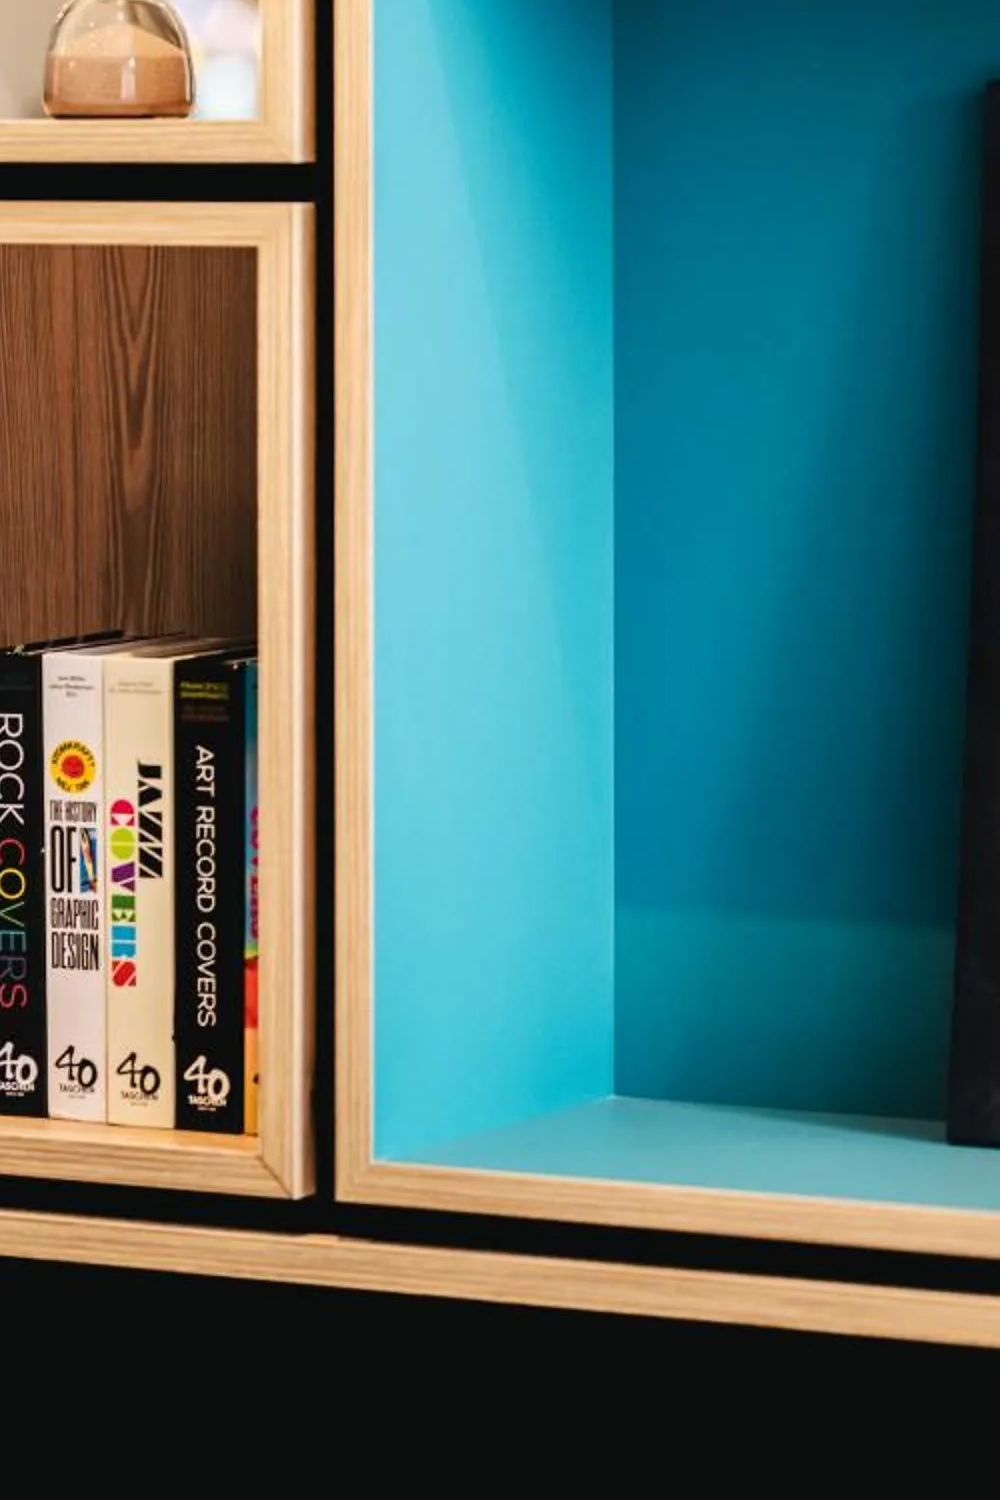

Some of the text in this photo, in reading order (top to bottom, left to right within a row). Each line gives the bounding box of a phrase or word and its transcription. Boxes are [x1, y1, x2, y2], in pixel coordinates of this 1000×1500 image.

[50, 799, 97, 822] THE HISTORY
[51, 825, 77, 893] OF
[110, 799, 137, 987] COVERS
[196, 745, 217, 1027] ART RECORD COVERS
[51, 898, 99, 931] GRAPHIC
[51, 931, 99, 971] DESIGN
[55, 1044, 98, 1088] 40
[116, 1051, 161, 1095] 40
[184, 1054, 231, 1100] 40
